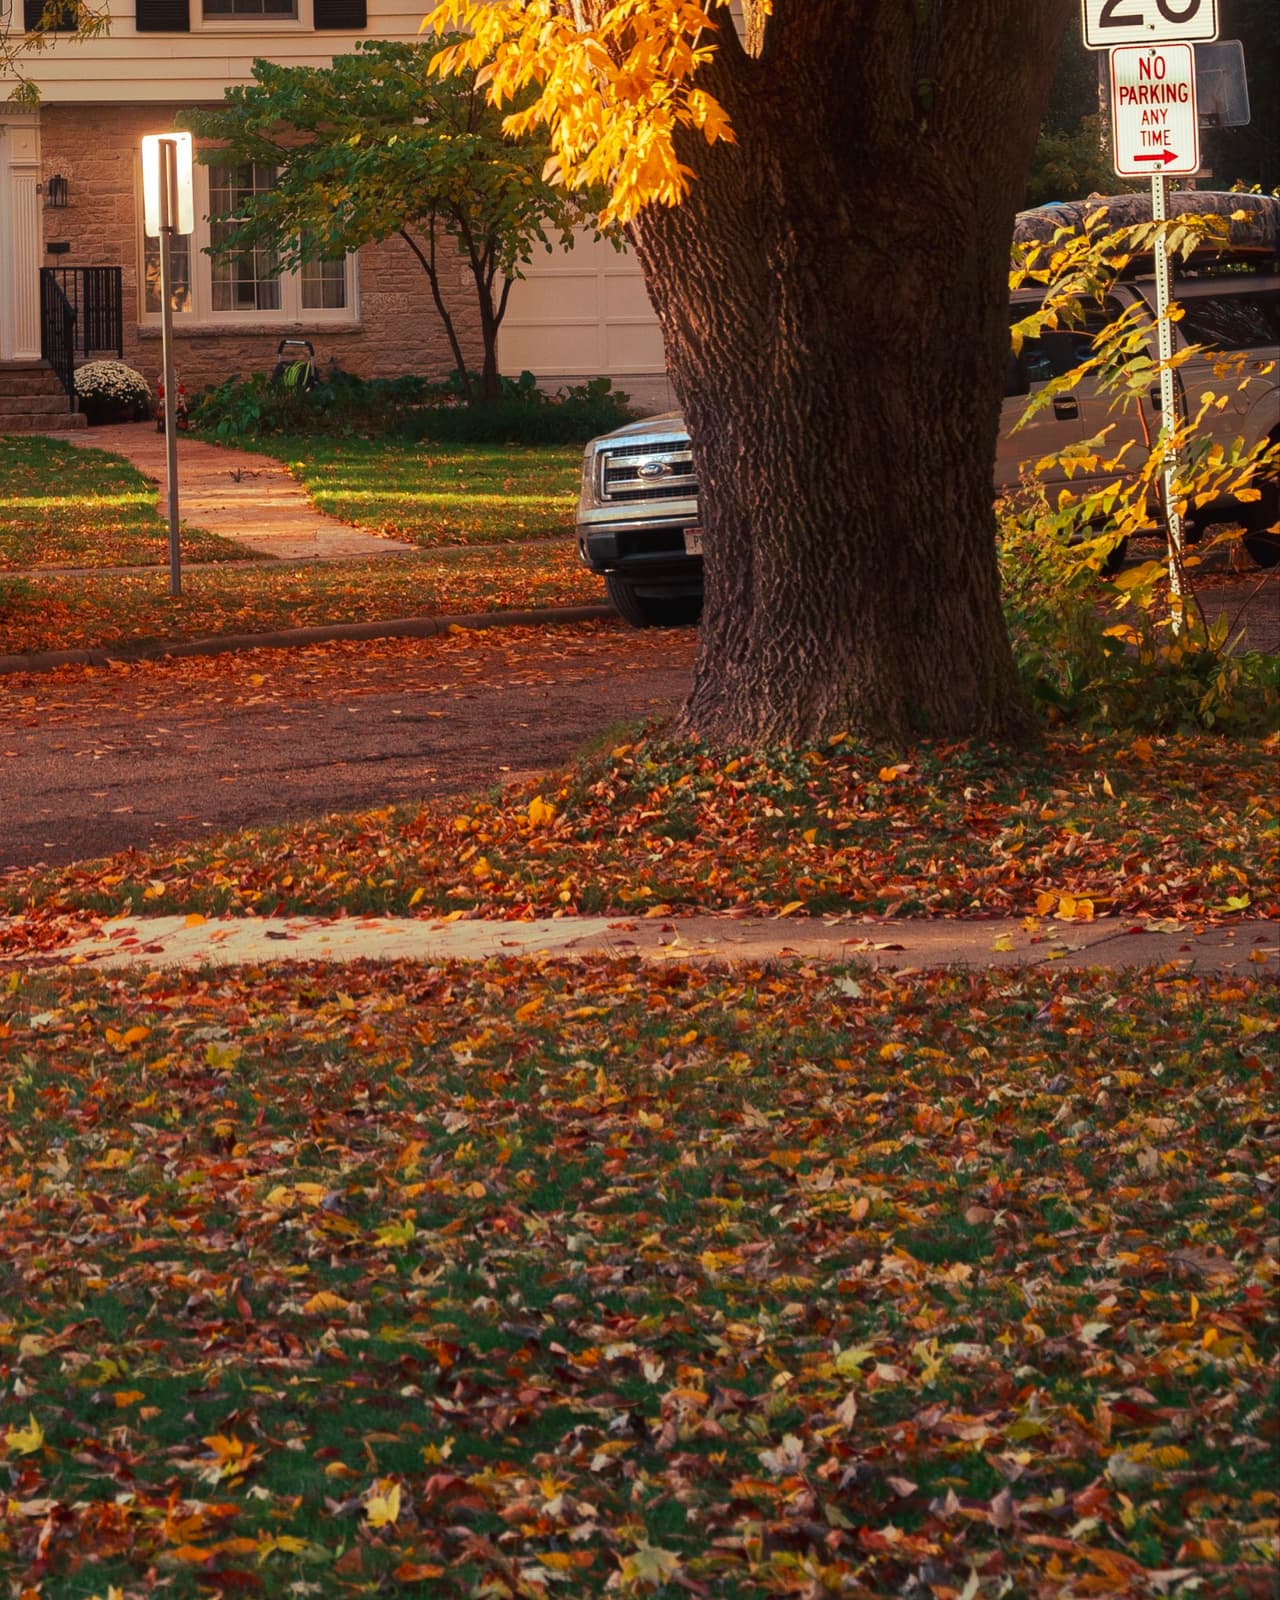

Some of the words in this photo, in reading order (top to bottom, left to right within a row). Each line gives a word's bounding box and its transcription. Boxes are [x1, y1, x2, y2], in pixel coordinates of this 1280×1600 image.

[1139, 55, 1166, 80] NO
[1119, 82, 1189, 107] PARKING
[1141, 108, 1168, 126] ANY
[1140, 129, 1171, 147] TIME
